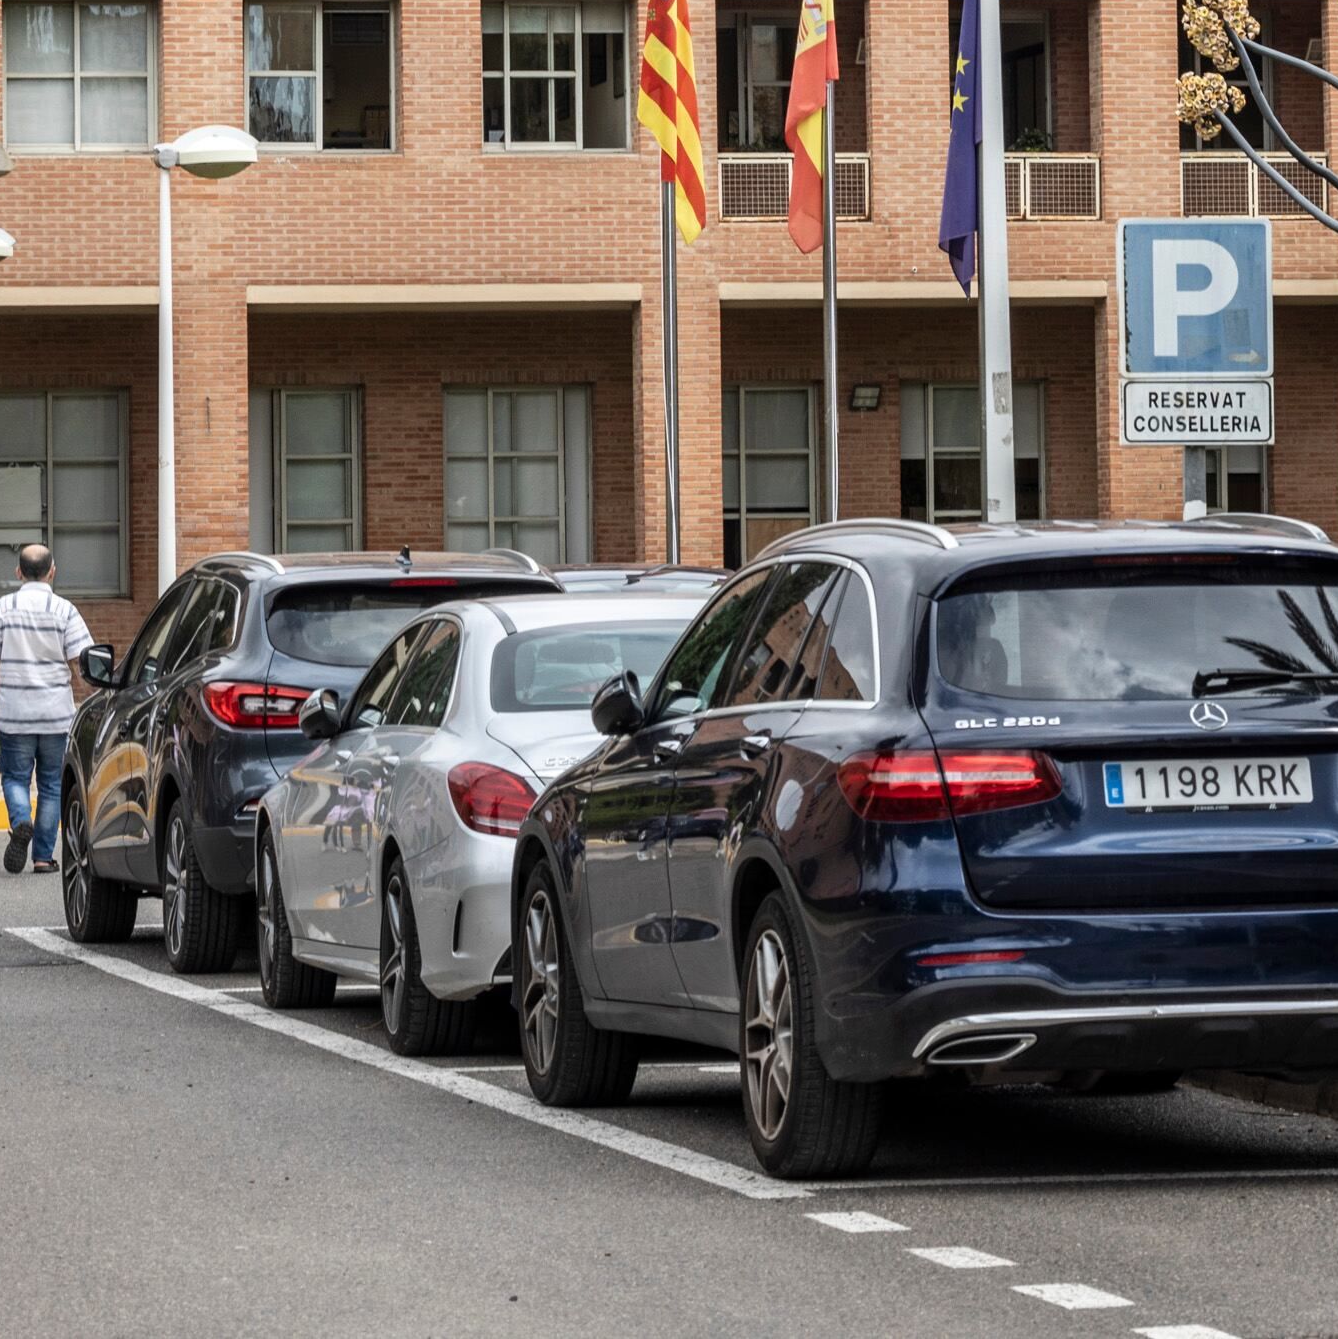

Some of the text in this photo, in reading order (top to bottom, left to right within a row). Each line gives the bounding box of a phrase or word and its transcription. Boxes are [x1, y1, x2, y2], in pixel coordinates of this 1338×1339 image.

[1152, 239, 1239, 357] P
[1148, 391, 1247, 409] RESERVAT
[1133, 414, 1262, 433] CONSELLERIA
[955, 716, 1061, 730] GLC 220d
[1135, 763, 1301, 799] 1198 KRK
